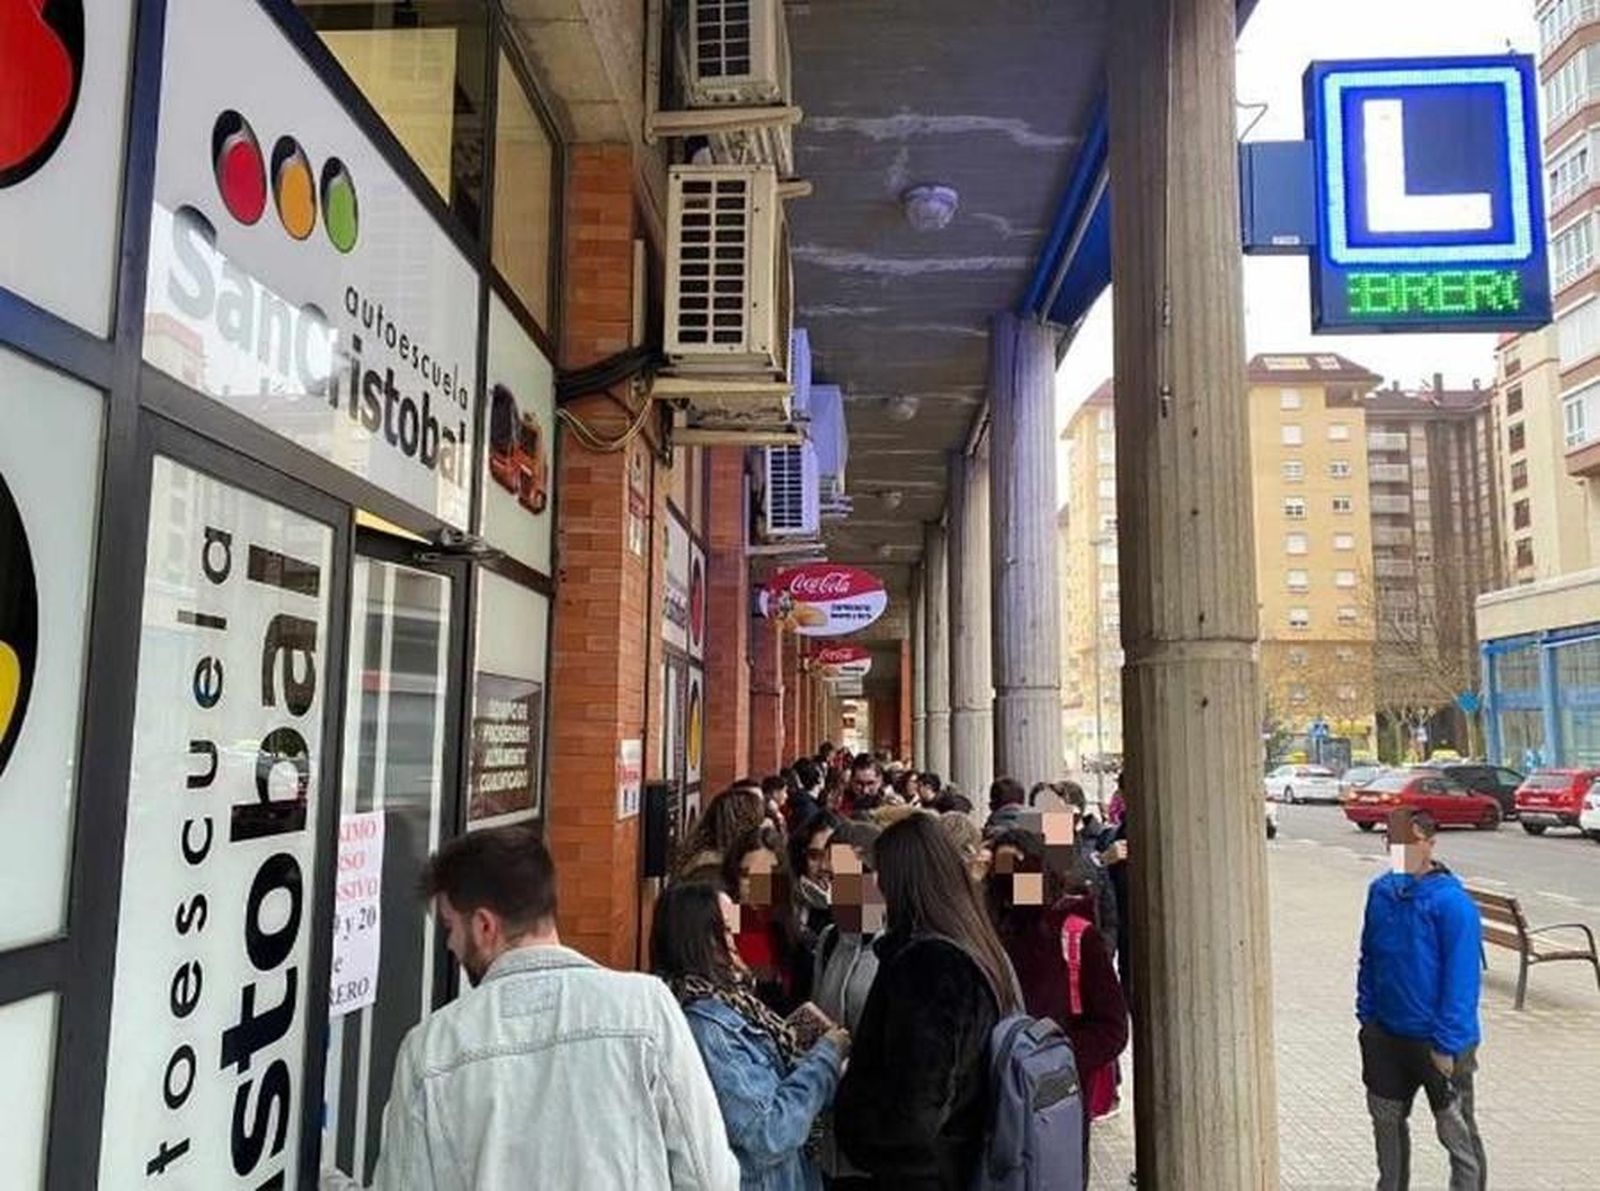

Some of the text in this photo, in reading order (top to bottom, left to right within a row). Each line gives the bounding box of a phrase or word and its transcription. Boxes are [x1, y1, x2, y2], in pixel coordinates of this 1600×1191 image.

[1363, 99, 1493, 233] L
[345, 286, 468, 410] autoescuela
[220, 543, 321, 1191] stobal
